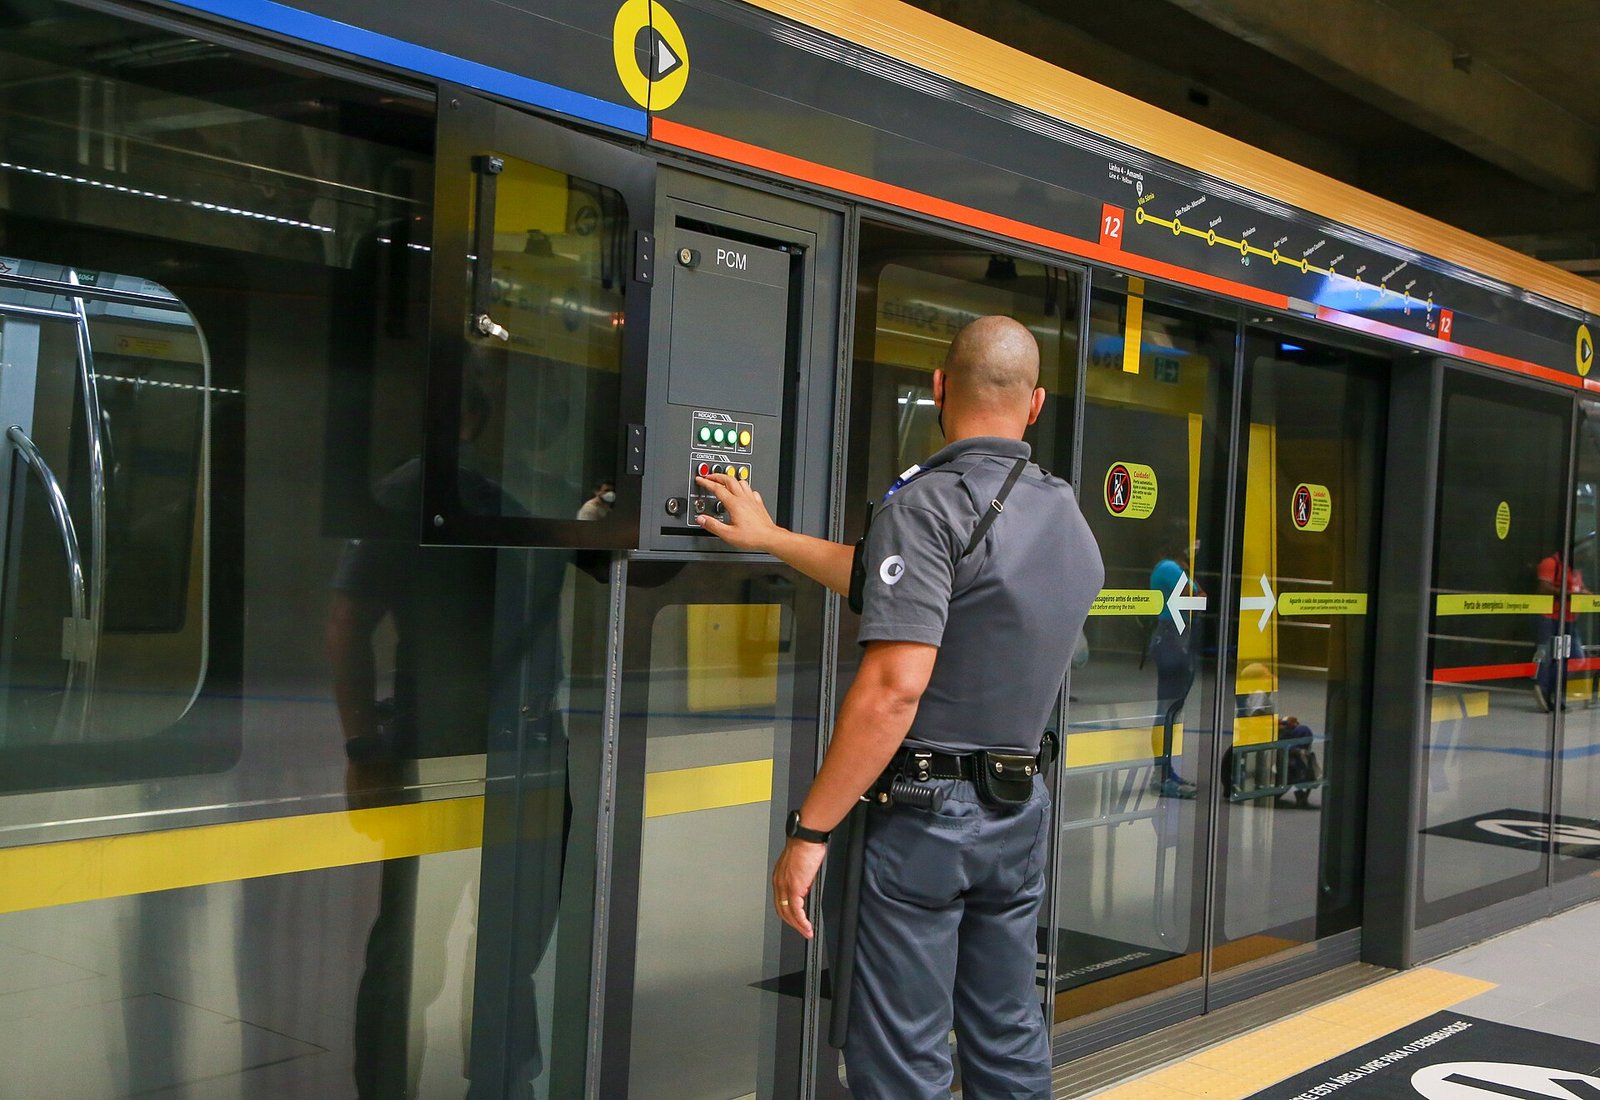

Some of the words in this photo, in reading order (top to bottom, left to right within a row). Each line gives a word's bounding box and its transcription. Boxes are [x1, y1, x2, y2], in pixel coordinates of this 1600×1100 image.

[1104, 216, 1121, 238] 12
[716, 248, 747, 270] PCM
[1440, 316, 1451, 334] 12
